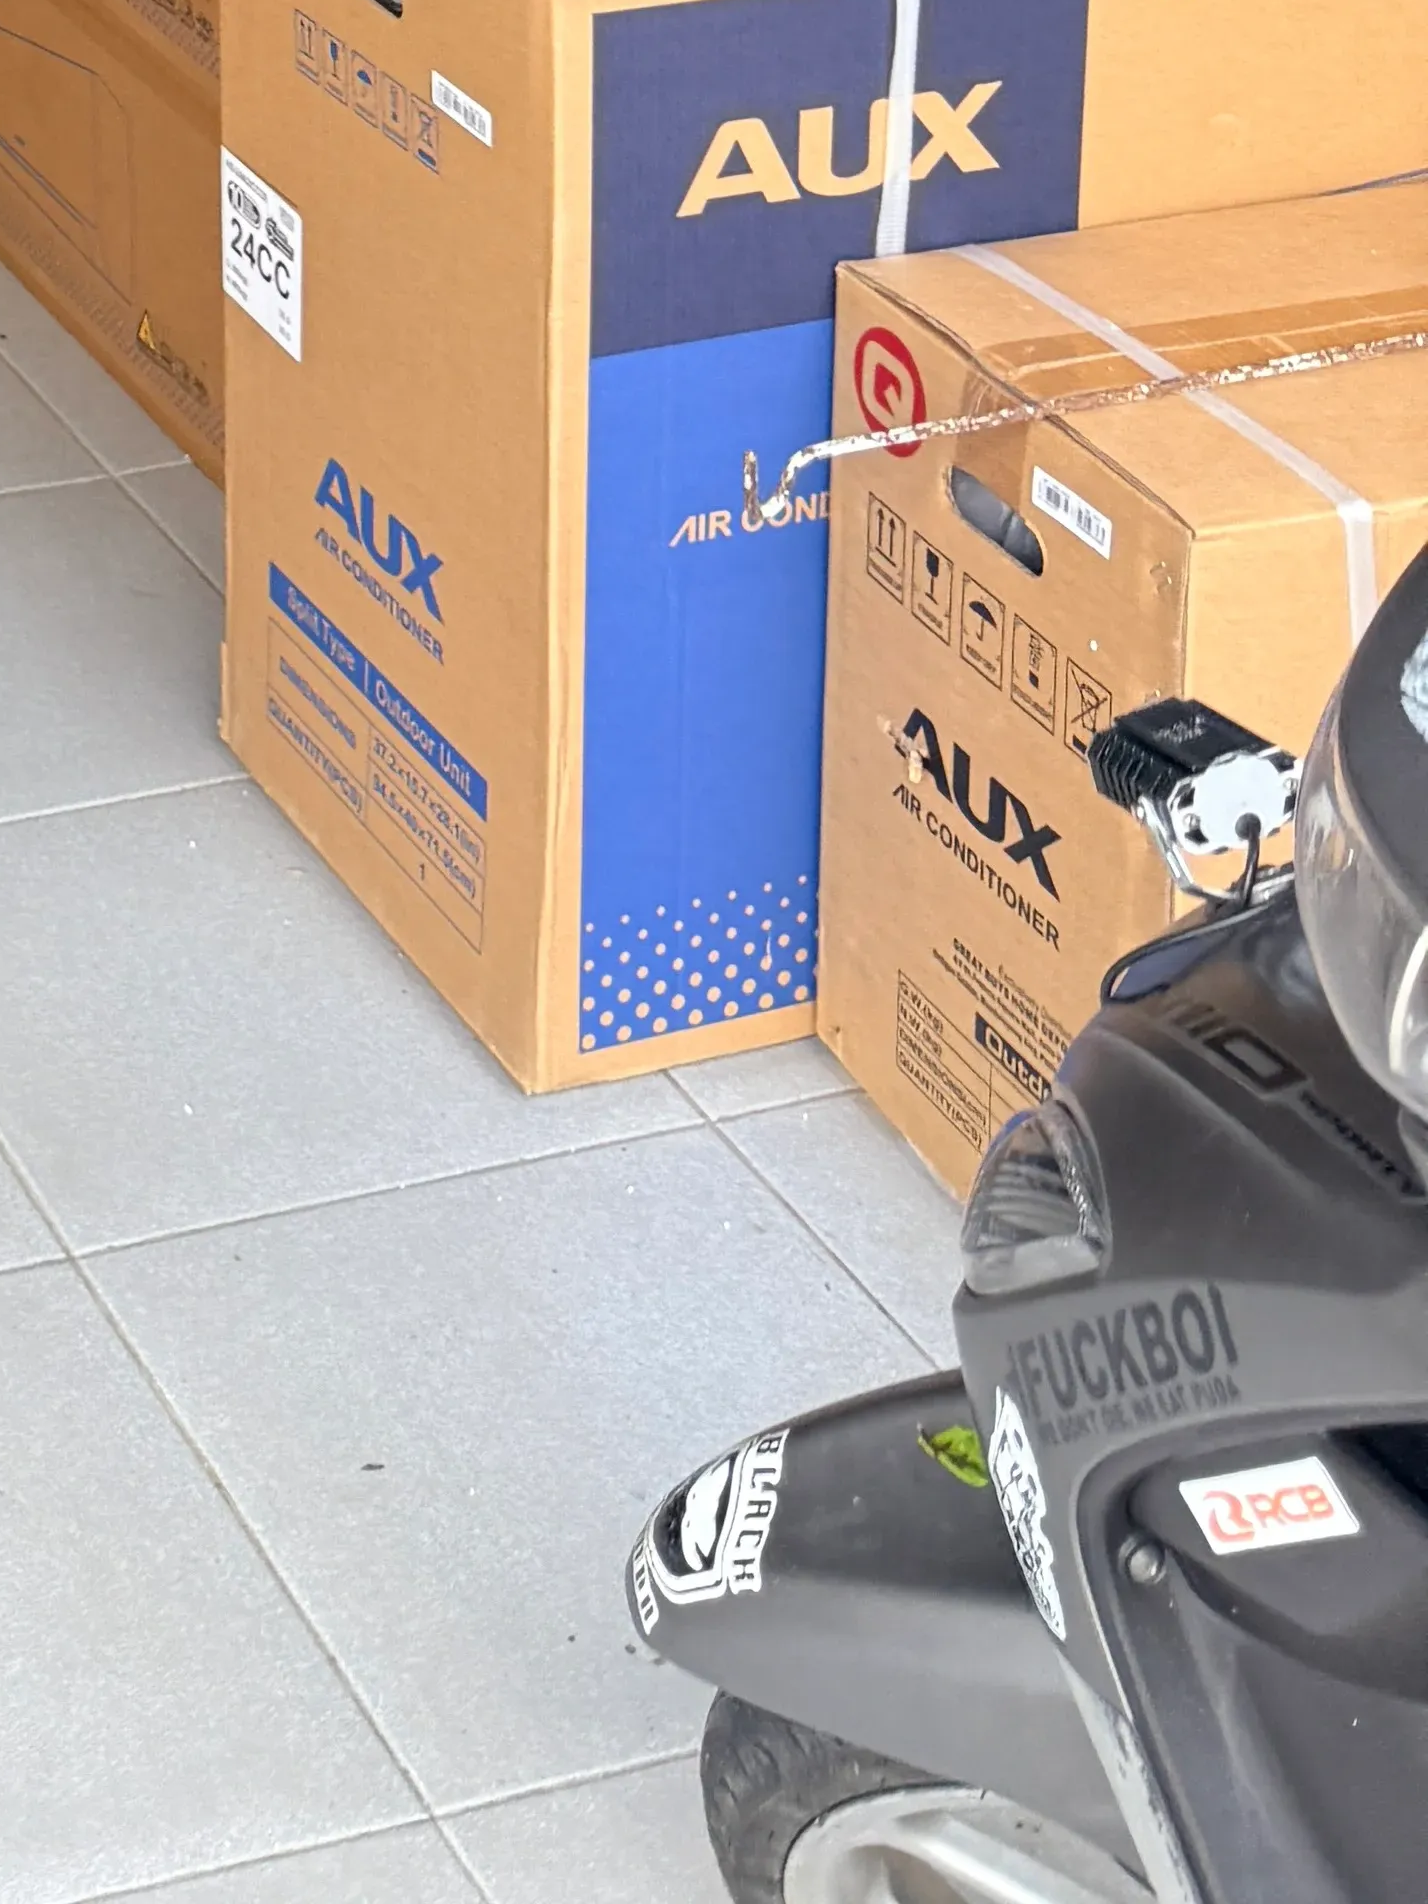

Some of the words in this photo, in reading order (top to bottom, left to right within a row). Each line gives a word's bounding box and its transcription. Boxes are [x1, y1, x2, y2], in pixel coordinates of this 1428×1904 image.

[676, 80, 1003, 218] AUX
[230, 217, 291, 300] 24CC
[313, 457, 445, 626] AUX
[314, 526, 339, 564] AIR
[340, 545, 445, 667] CONDITIONER
[669, 509, 733, 548] AIR
[375, 679, 435, 758] Outdoor
[438, 742, 471, 798] Unit
[892, 708, 1062, 903] AUX
[892, 783, 923, 825] AIR
[925, 810, 1062, 953] CONDITIONER
[1251, 1482, 1336, 1529] RCB
